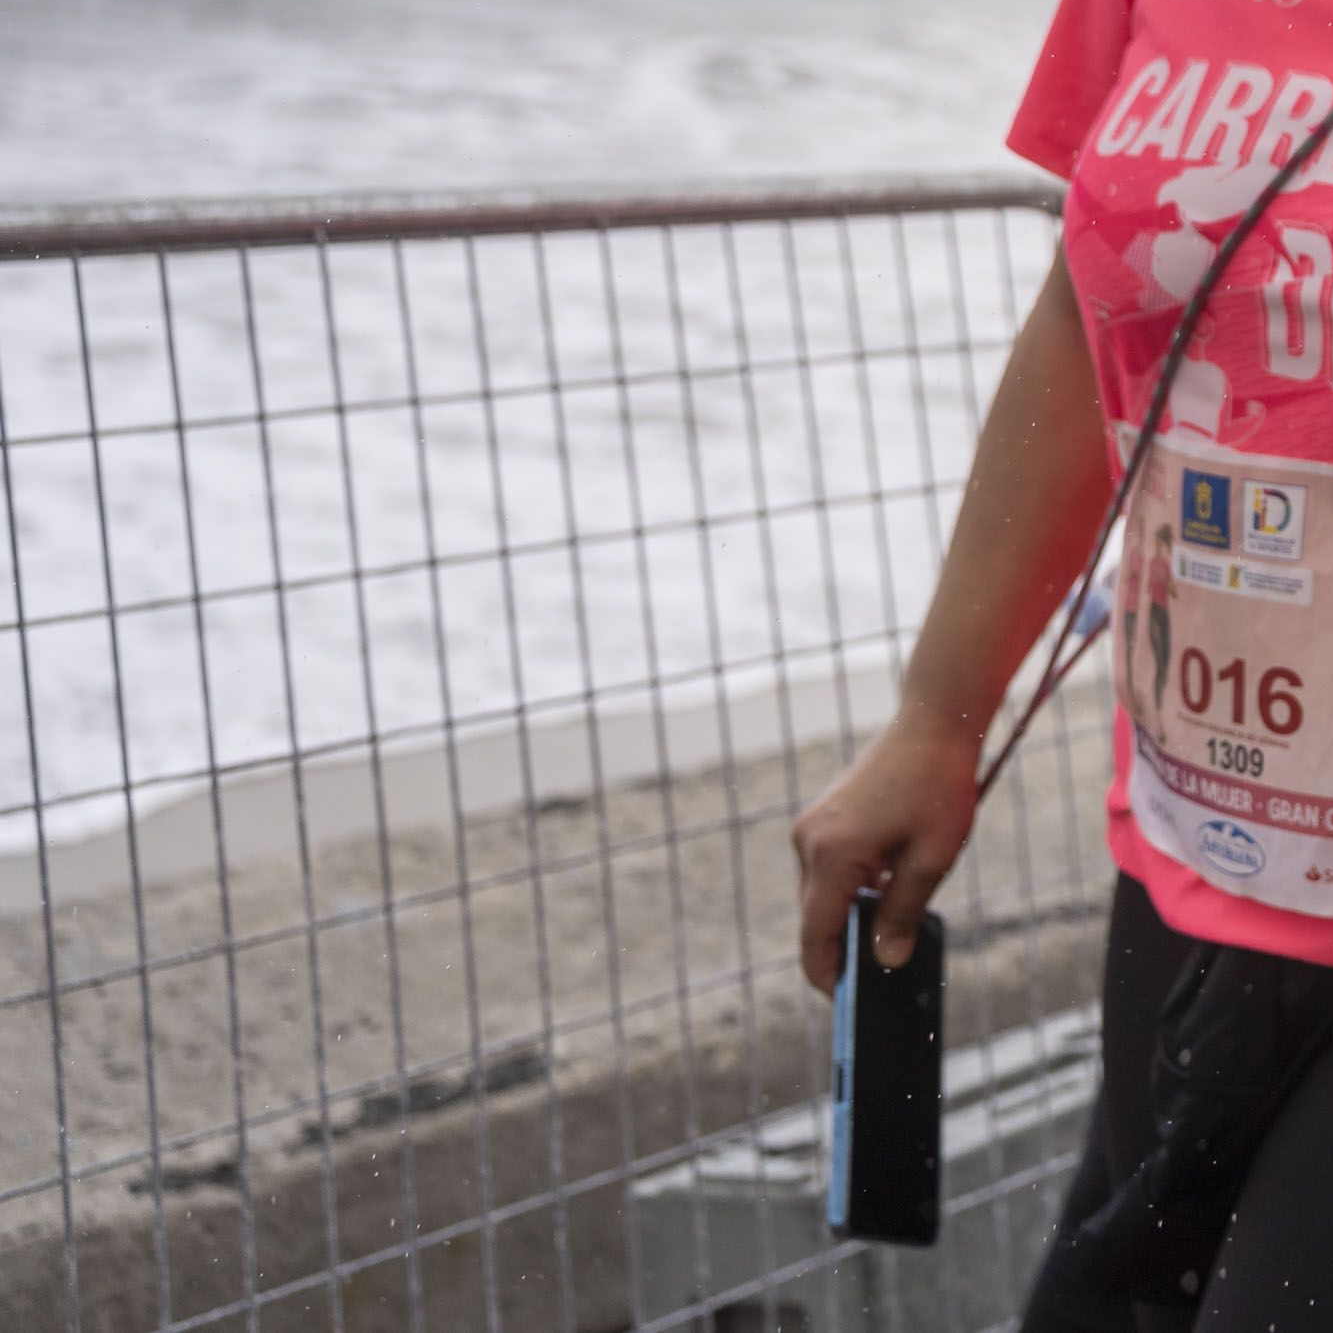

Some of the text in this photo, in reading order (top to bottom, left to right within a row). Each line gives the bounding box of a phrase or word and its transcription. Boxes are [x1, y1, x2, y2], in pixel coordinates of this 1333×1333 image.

[1180, 646, 1304, 736] 016
[1206, 737, 1265, 778] 1309
[1200, 777, 1253, 813] MUJER
[1266, 796, 1320, 829] GRAN
